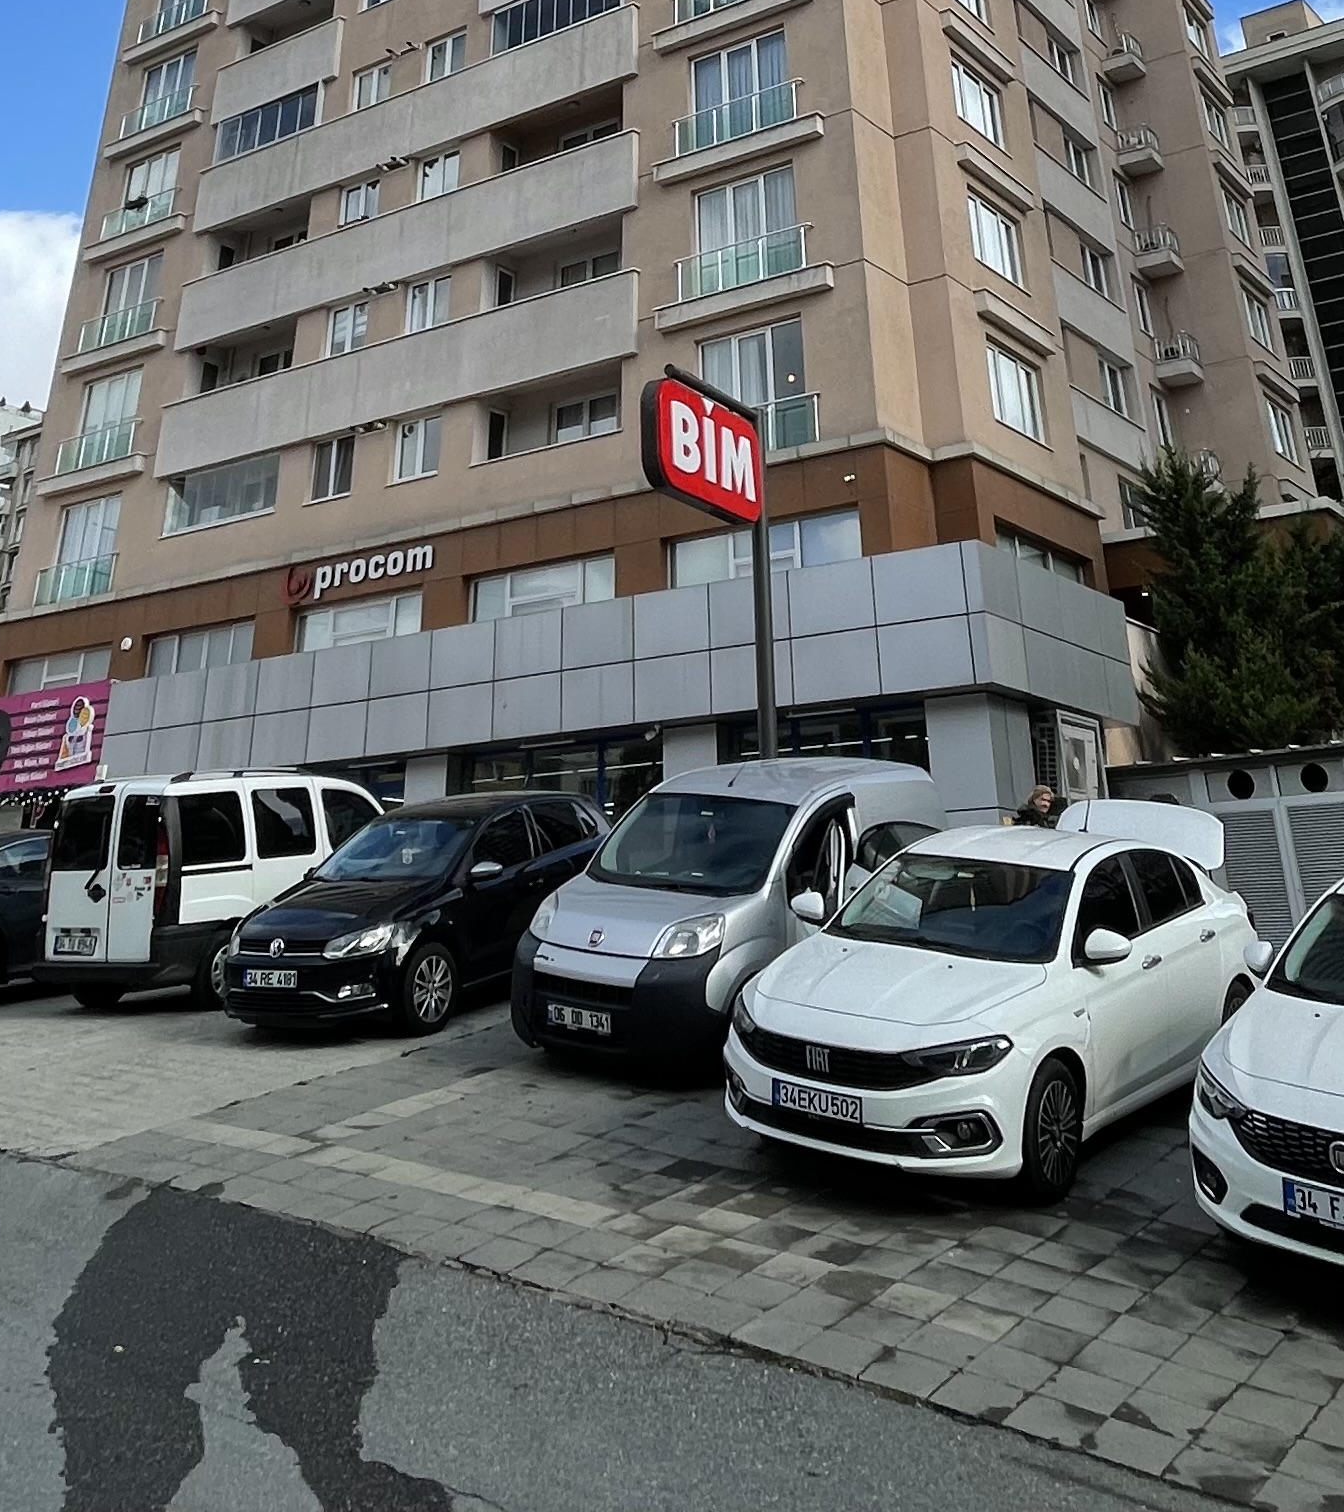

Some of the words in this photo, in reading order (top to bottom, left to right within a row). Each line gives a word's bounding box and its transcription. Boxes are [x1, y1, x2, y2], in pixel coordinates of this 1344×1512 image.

[313, 545, 434, 600] procom
[246, 971, 258, 985] 34
[259, 972, 274, 986] RE
[806, 1045, 830, 1073] FIAT
[1296, 1188, 1318, 1214] 34
